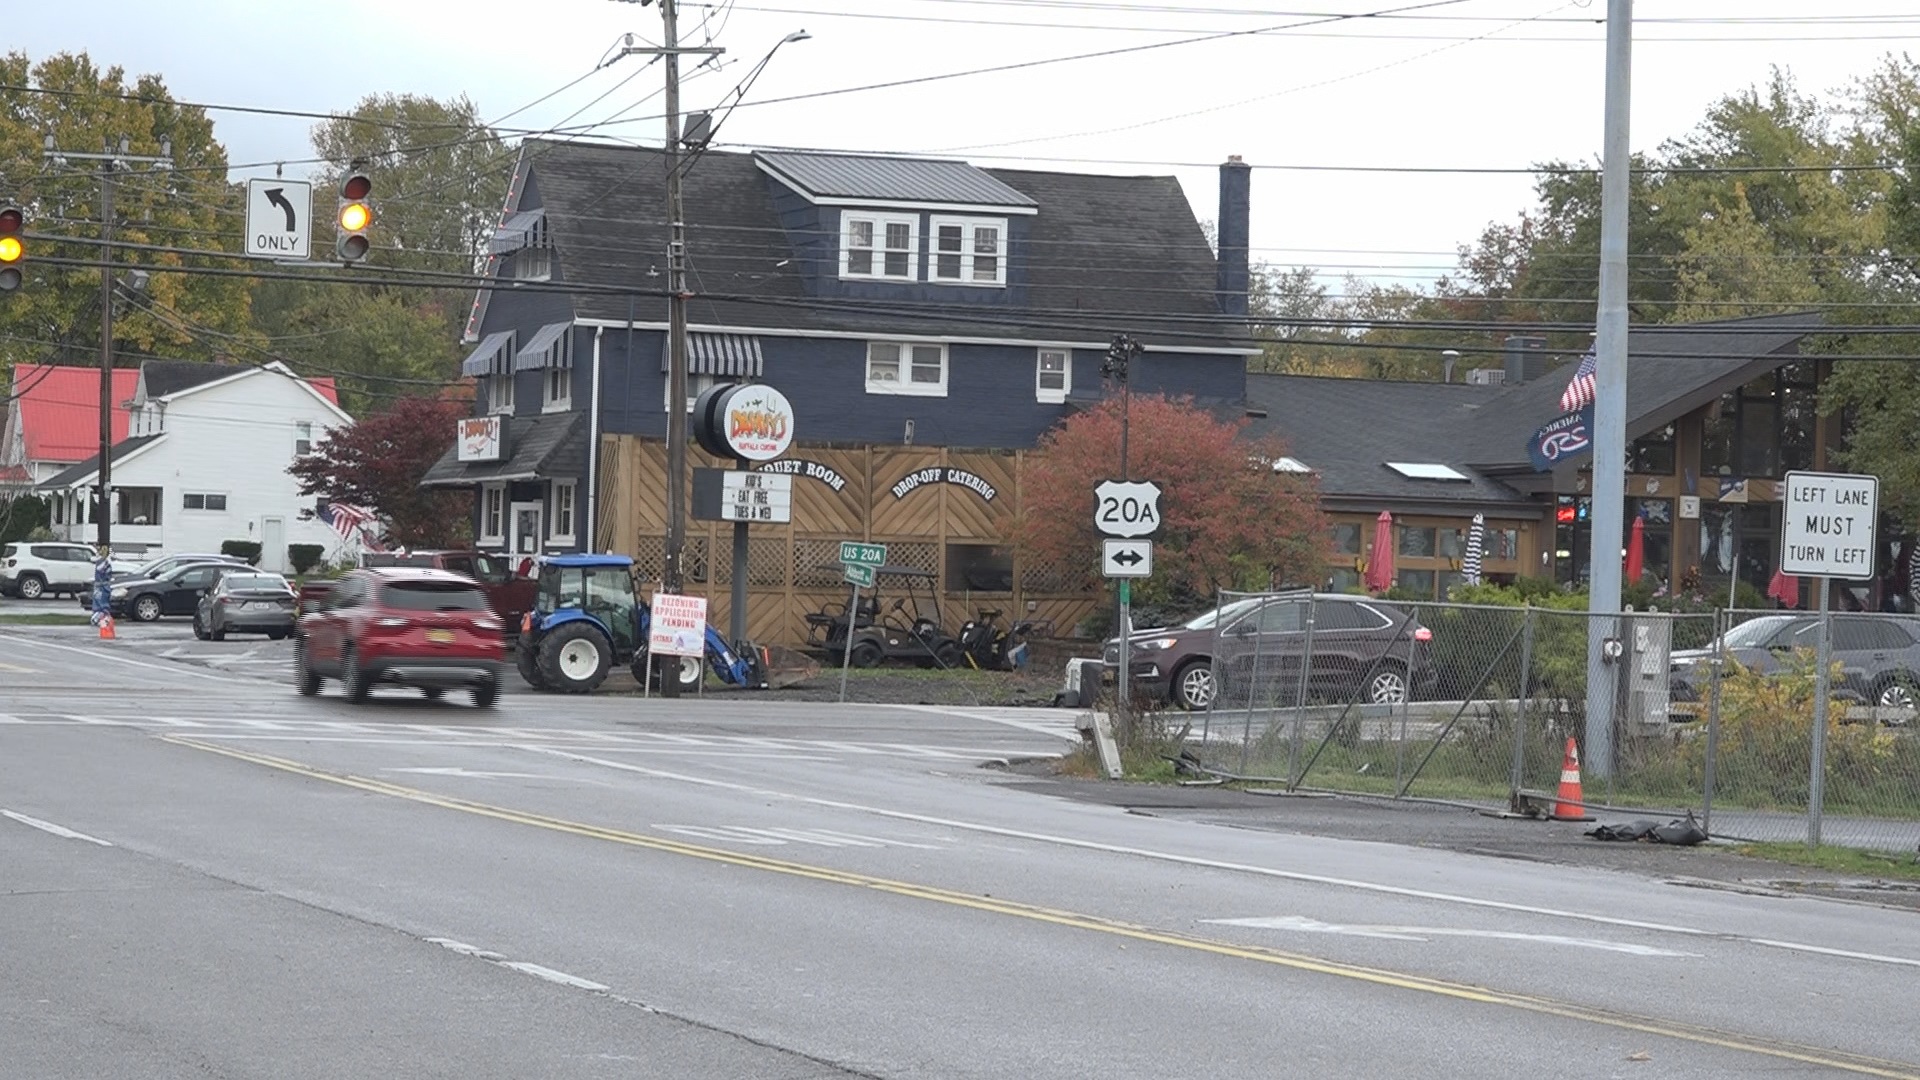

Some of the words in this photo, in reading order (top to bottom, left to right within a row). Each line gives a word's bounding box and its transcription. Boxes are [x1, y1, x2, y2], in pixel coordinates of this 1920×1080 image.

[257, 234, 299, 251] ONLY
[806, 461, 845, 491] ROOM
[892, 468, 942, 498] DROP-OFF
[947, 469, 996, 500] CATERING
[738, 490, 750, 503] EAT
[754, 491, 768, 504] FREE
[1794, 487, 1826, 503] LEFT
[1835, 489, 1869, 506] LANE
[734, 505, 749, 519] TUES
[759, 507, 772, 520] WED
[1103, 496, 1155, 523] 20A
[1806, 515, 1854, 536] MUST
[844, 546, 858, 560] US
[861, 548, 881, 562] 20A
[1790, 545, 1825, 562] TURN
[1834, 547, 1866, 564] LEFT
[661, 597, 699, 609] REZONING
[654, 606, 705, 619] APPLICATION
[662, 617, 696, 629] PENDING
